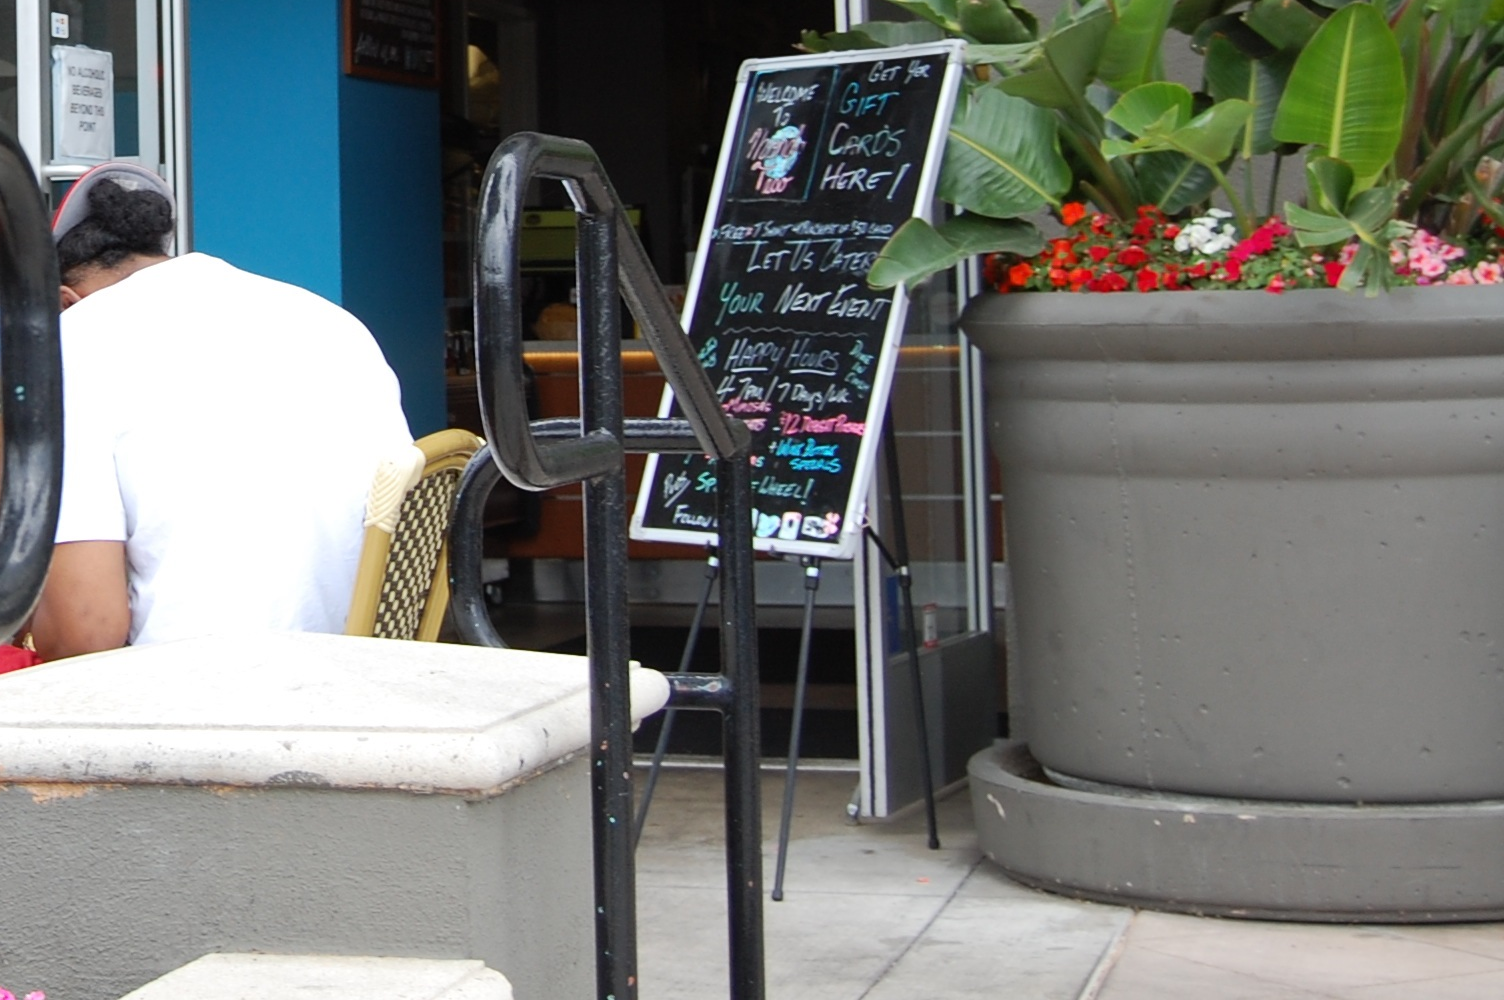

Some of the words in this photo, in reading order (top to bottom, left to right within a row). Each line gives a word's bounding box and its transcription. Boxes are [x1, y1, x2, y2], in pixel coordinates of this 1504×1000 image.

[868, 61, 901, 83] GET
[757, 82, 820, 103] WELCOME
[839, 83, 899, 116] GIFT
[70, 103, 93, 115] BEYOND
[79, 121, 96, 132] POINT
[747, 241, 791, 273] LET
[716, 282, 765, 326] YOUR
[774, 282, 831, 315] NEXT
[827, 283, 891, 320] EVENT
[724, 338, 785, 374] HAPPY
[784, 338, 840, 370] HOURS
